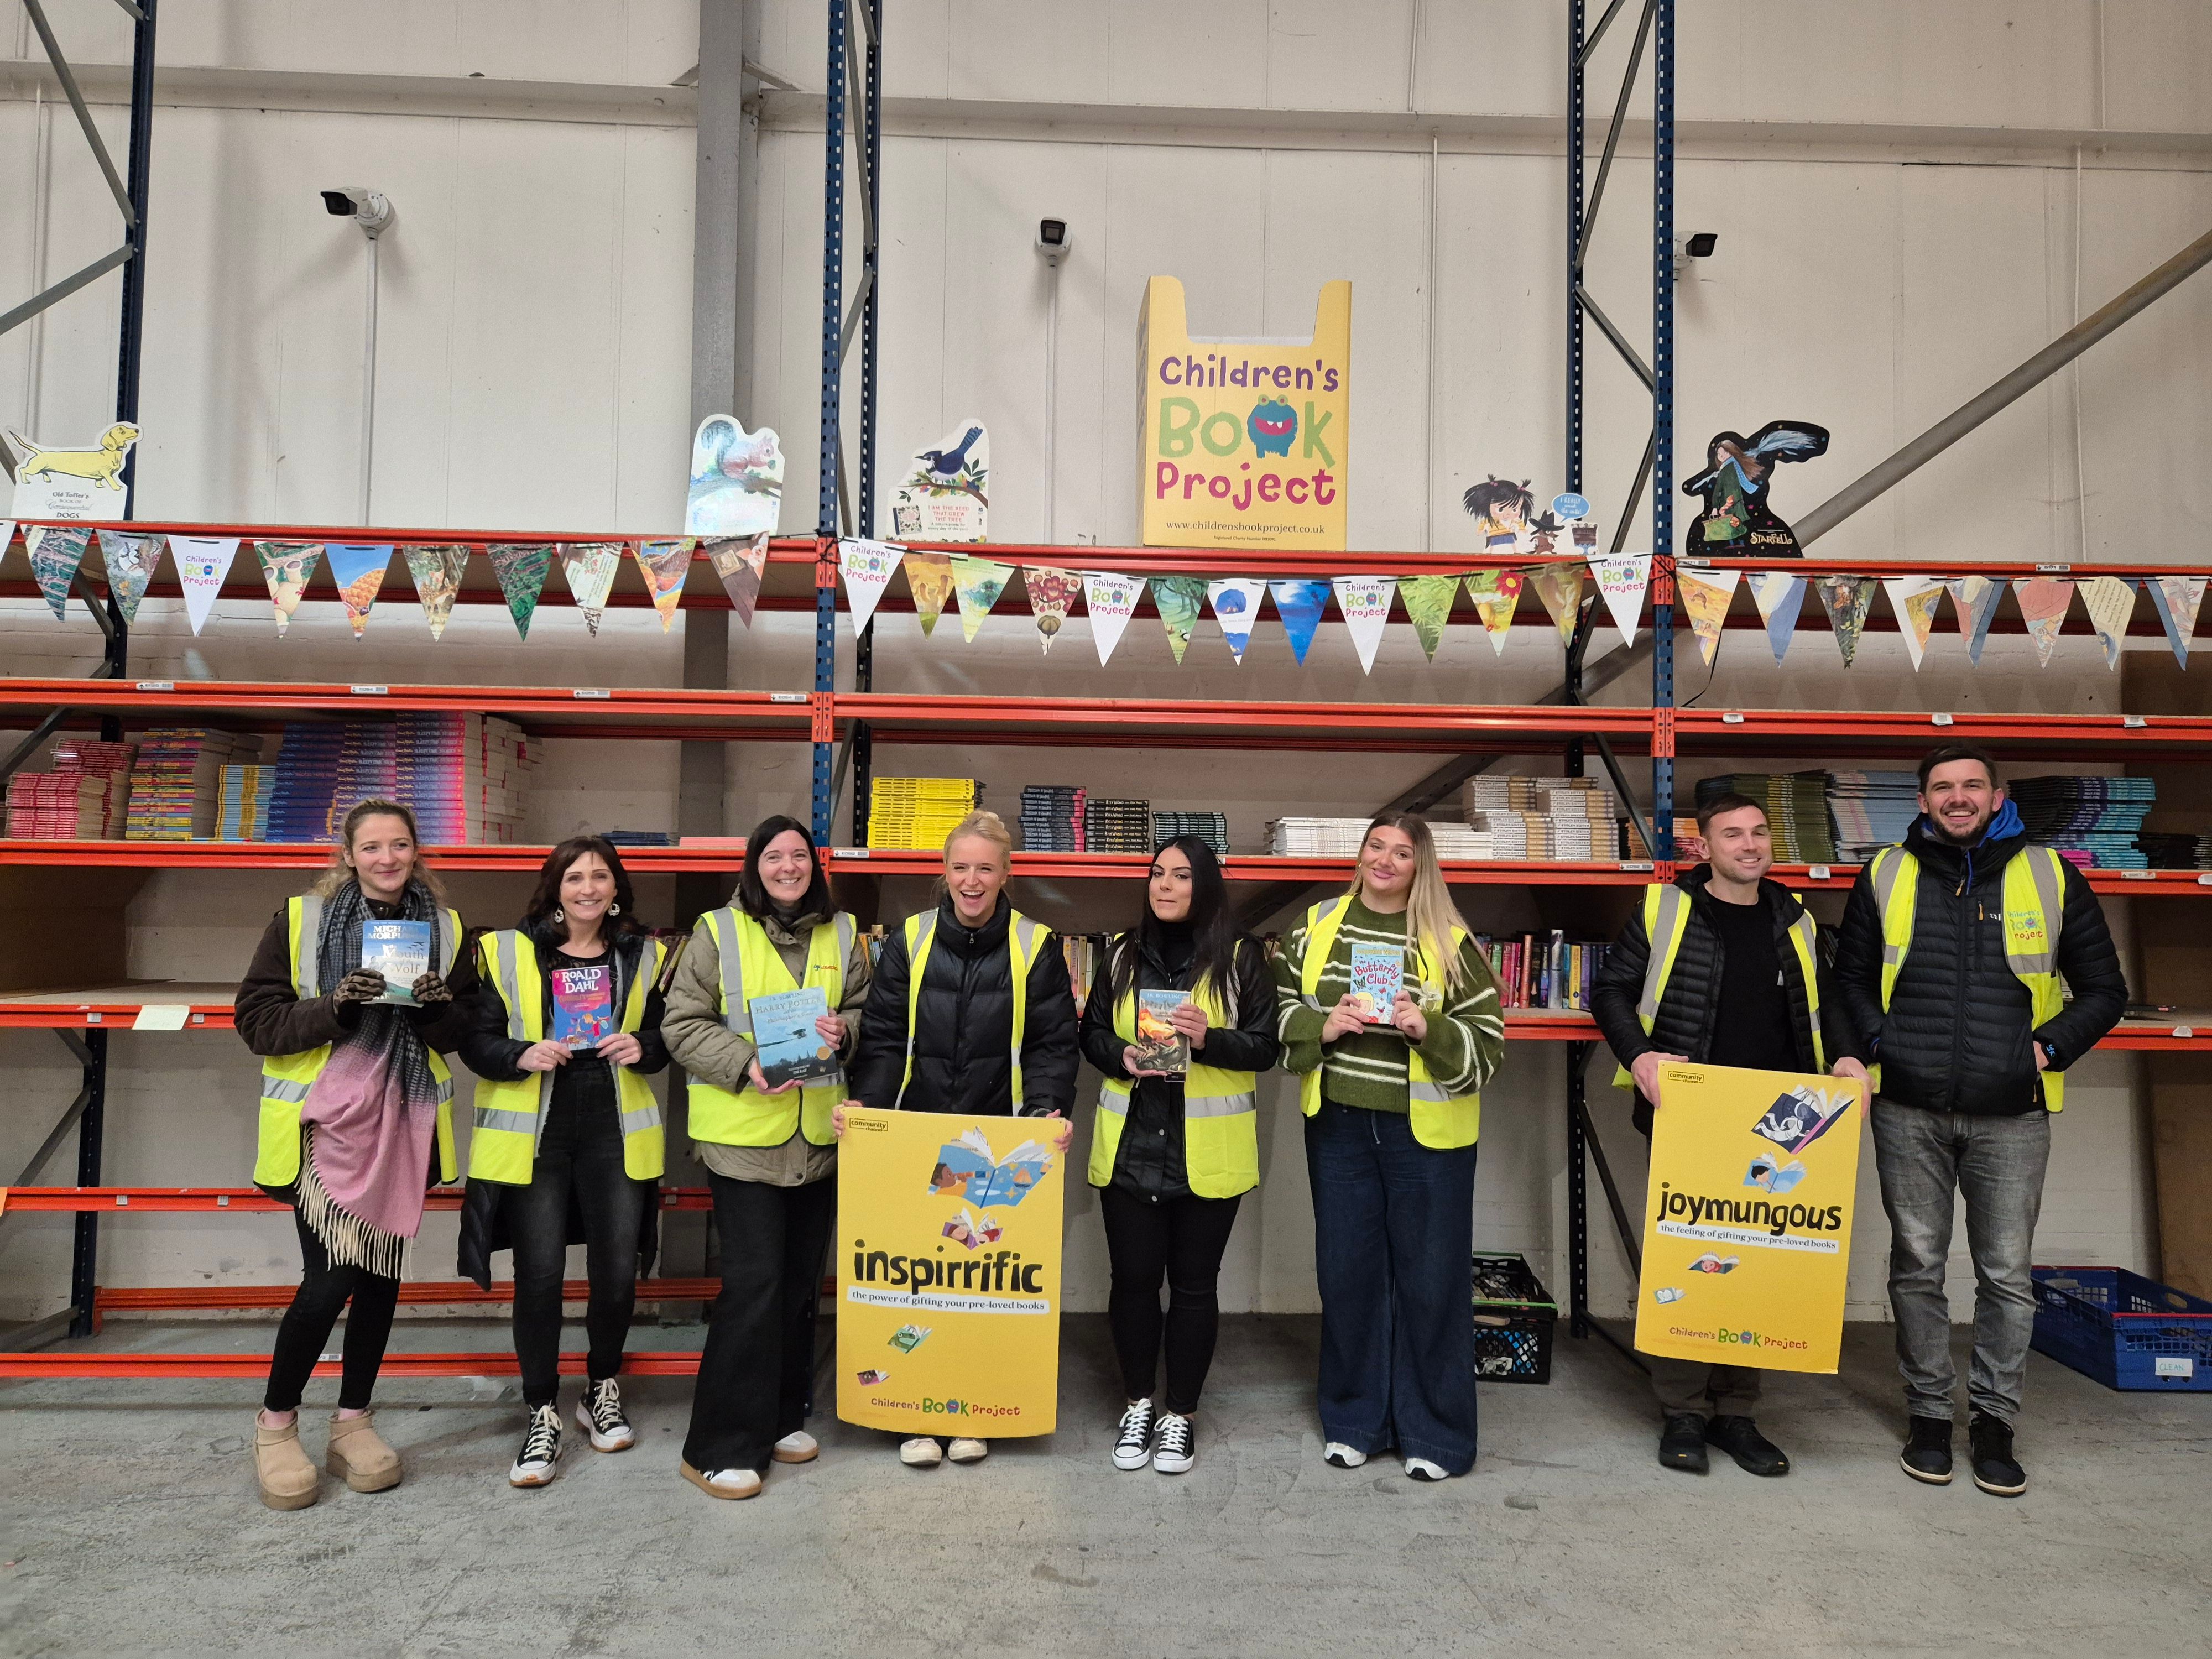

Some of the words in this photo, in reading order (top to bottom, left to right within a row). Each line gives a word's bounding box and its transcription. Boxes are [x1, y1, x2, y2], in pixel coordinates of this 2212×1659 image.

[1160, 353, 1338, 392] Children's
[1157, 461, 1335, 511] Project
[1166, 521, 1324, 534] www.childrensbookproject.co.uk
[851, 546, 891, 559] Children's
[1601, 559, 1641, 567] Children's
[184, 576, 220, 586] Project
[846, 568, 887, 583] Project
[1093, 579, 1133, 591] Children's
[1603, 582, 1645, 593] Project
[1090, 602, 1130, 615] Project
[1346, 607, 1386, 618] Project
[561, 969, 601, 983] ROALD
[1354, 961, 1399, 979] Butterfly
[1366, 973, 1388, 984] Club
[565, 980, 599, 993] DAHL
[755, 1003, 786, 1014] HARRY
[789, 997, 823, 1010] POTTER
[851, 1120, 886, 1129] community
[1657, 1182, 1842, 1236] joymungous
[1677, 1225, 1705, 1237] feeling
[1717, 1231, 1746, 1242] gifting
[1747, 1234, 1767, 1243] your
[1769, 1236, 1809, 1246] pre-loved
[1811, 1240, 1835, 1249] books
[854, 1239, 1043, 1295] inspirrific
[852, 1291, 867, 1299] the
[869, 1294, 898, 1303] power
[912, 1296, 943, 1308] gifting
[945, 1300, 967, 1308] your
[969, 1300, 1014, 1310] pre-loved
[1016, 1301, 1045, 1310] books
[1669, 1327, 1715, 1339] Children's
[1764, 1337, 1808, 1349] Project
[2159, 1363, 2184, 1371] CLEAN
[871, 1397, 920, 1410] Children's
[972, 1404, 1020, 1417] Project
